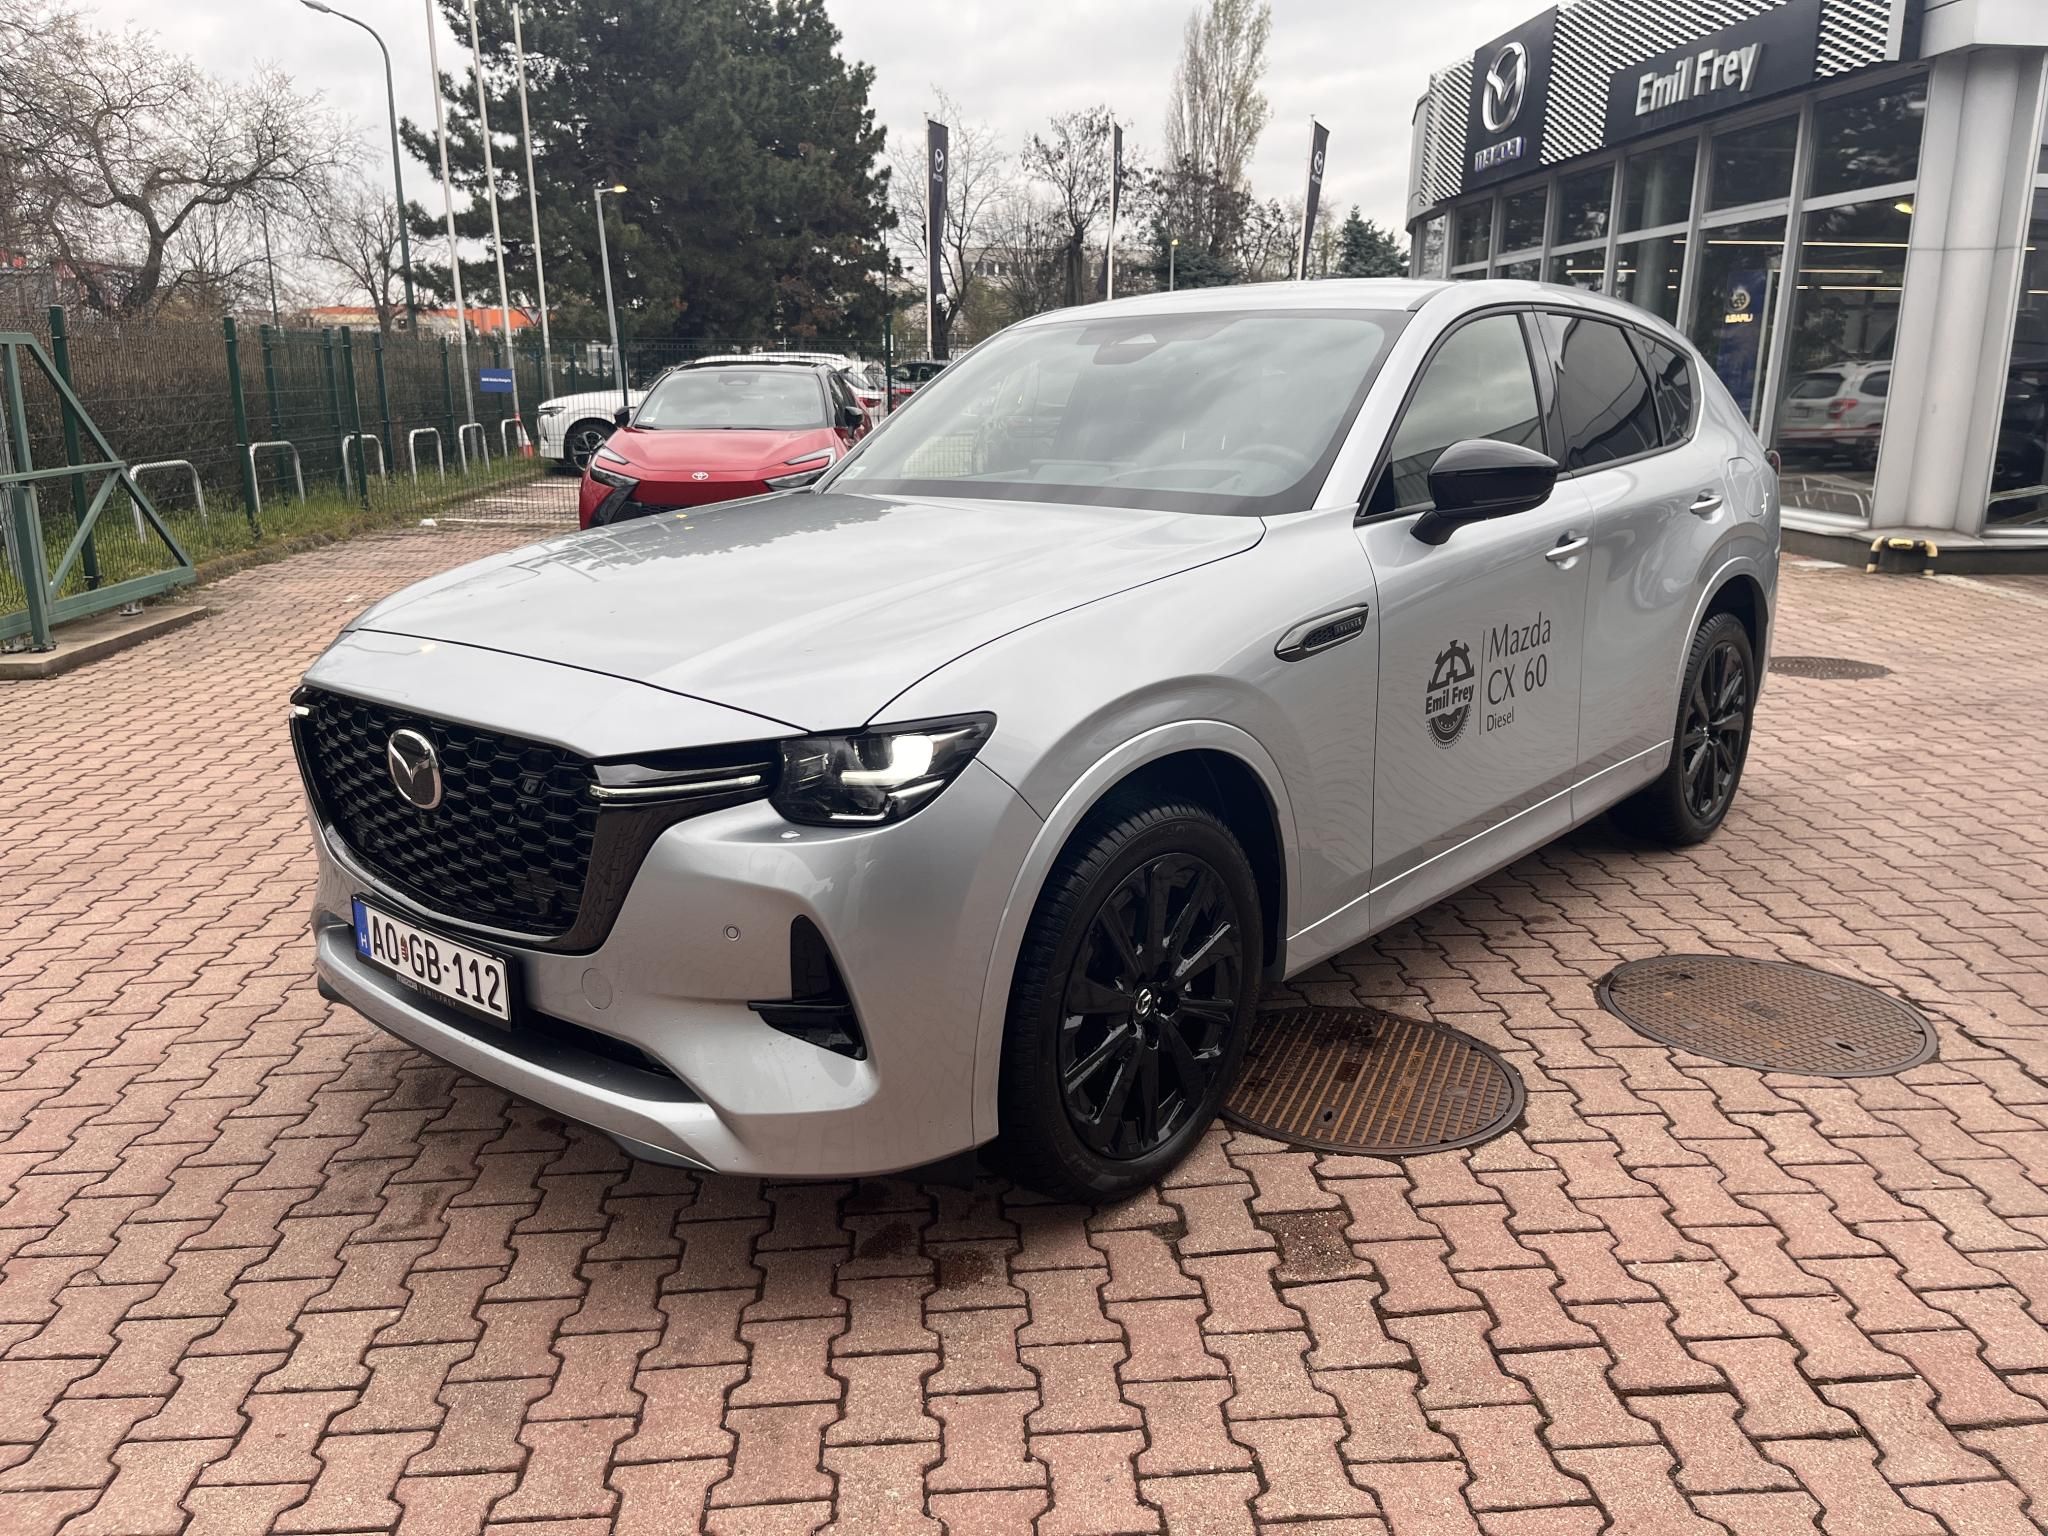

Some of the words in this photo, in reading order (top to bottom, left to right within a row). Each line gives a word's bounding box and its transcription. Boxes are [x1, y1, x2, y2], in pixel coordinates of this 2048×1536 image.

[1635, 56, 1694, 116] Emil
[1694, 42, 1761, 96] Frey
[1489, 611, 1551, 662] Mazda
[1425, 688, 1449, 715] Emil
[1452, 684, 1474, 705] Frey
[1487, 663, 1515, 705] CX
[1524, 653, 1547, 692] 60
[1486, 705, 1514, 732] Diesel
[360, 931, 368, 949] H
